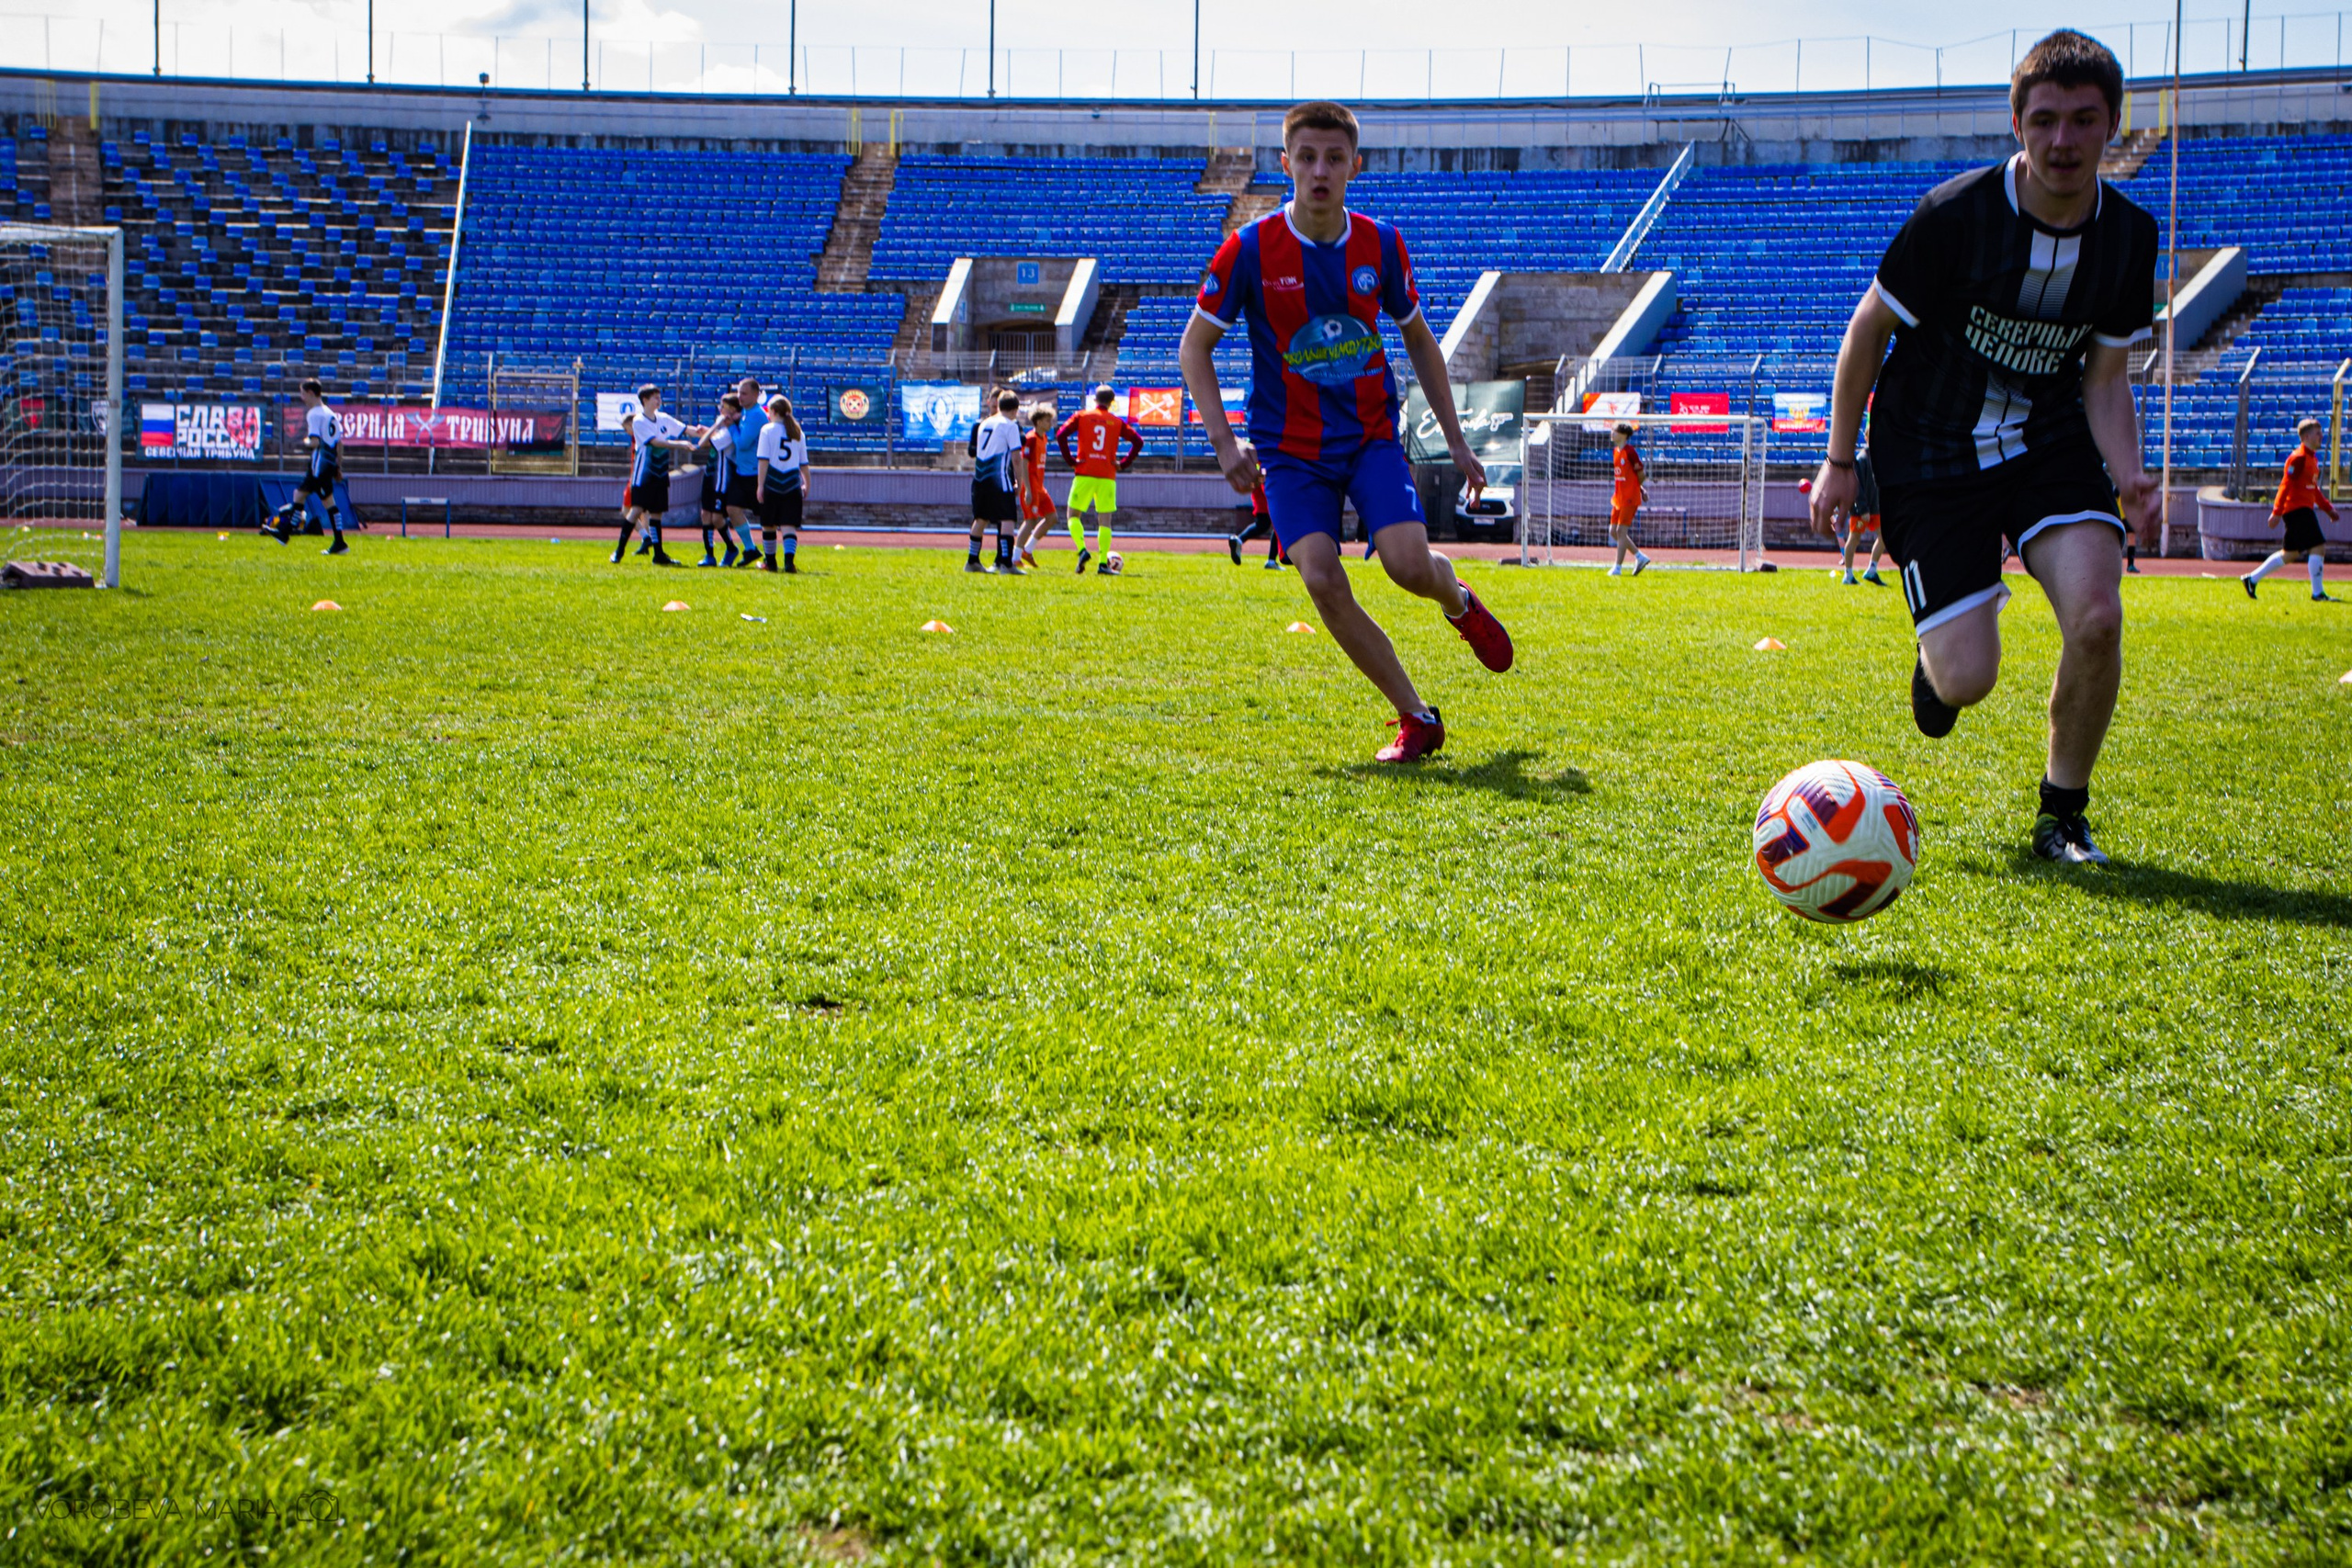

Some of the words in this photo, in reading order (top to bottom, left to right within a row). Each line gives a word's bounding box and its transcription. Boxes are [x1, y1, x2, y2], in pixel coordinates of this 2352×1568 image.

[1965, 323, 2065, 375] ЧЕЛОВЕ
[176, 404, 261, 430] СЛАВА
[328, 415, 336, 437] 6
[333, 412, 405, 439] ВЕРНАЯ
[777, 437, 792, 461] 5
[981, 428, 993, 450] 7
[1091, 424, 1106, 451] 3
[205, 446, 255, 460] ТРИБУНА
[1405, 483, 1418, 513] 7
[1904, 559, 1927, 615] 11
